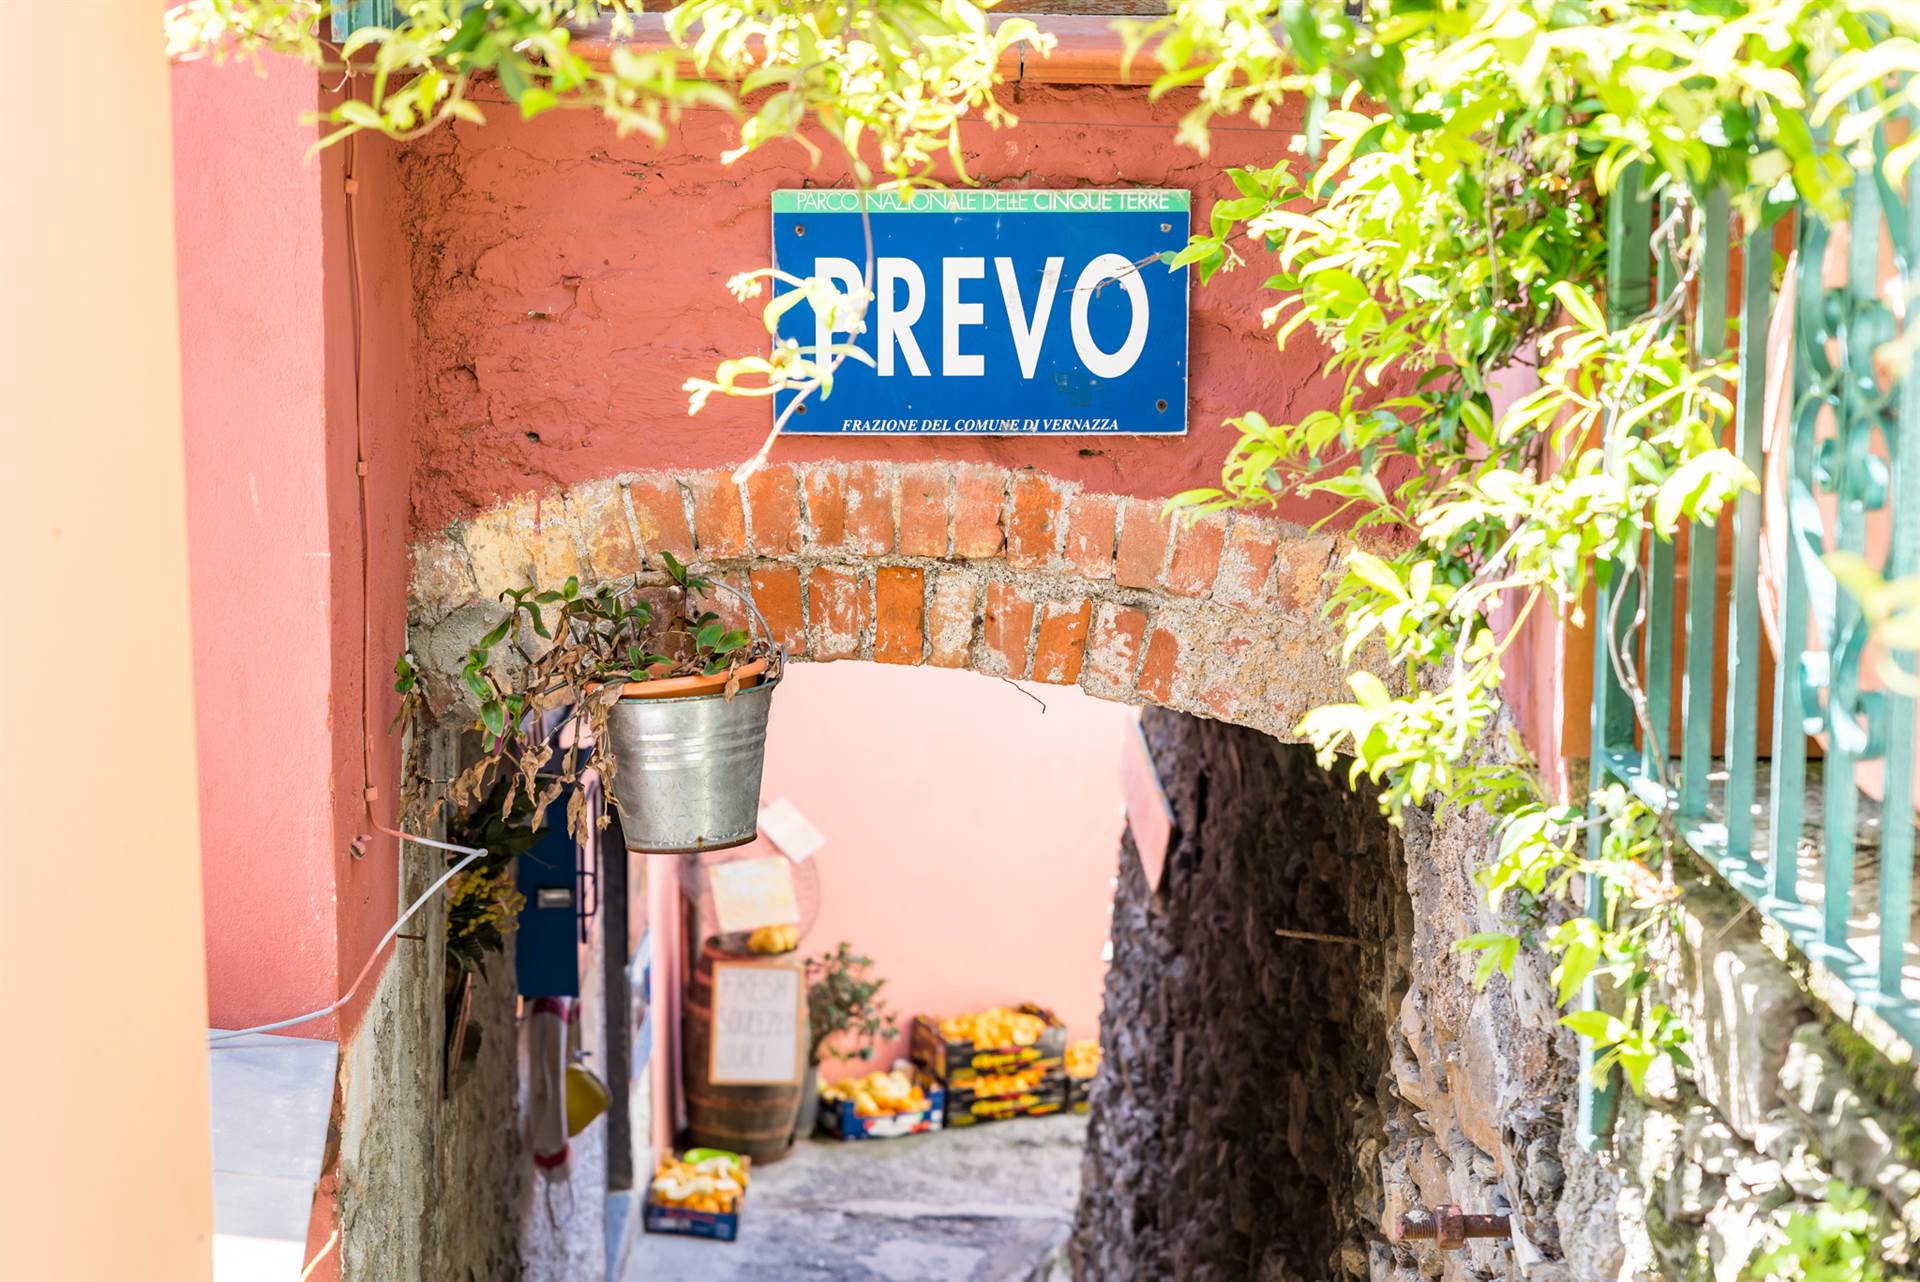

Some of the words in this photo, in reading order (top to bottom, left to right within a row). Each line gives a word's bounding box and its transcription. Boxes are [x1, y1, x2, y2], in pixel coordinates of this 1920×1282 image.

[796, 191, 860, 211] PARCO
[865, 191, 977, 211] NAZIONALE
[982, 191, 1028, 210] DELLE
[1033, 191, 1112, 211] CINQUE
[1117, 190, 1170, 210] TERRE
[814, 252, 1150, 379] PREVO
[841, 418, 918, 432] FRAZIONE
[920, 418, 952, 432] DEL
[954, 418, 1020, 432] COMUNE
[1022, 418, 1040, 432] DI
[1043, 418, 1119, 431] VERNAZZA
